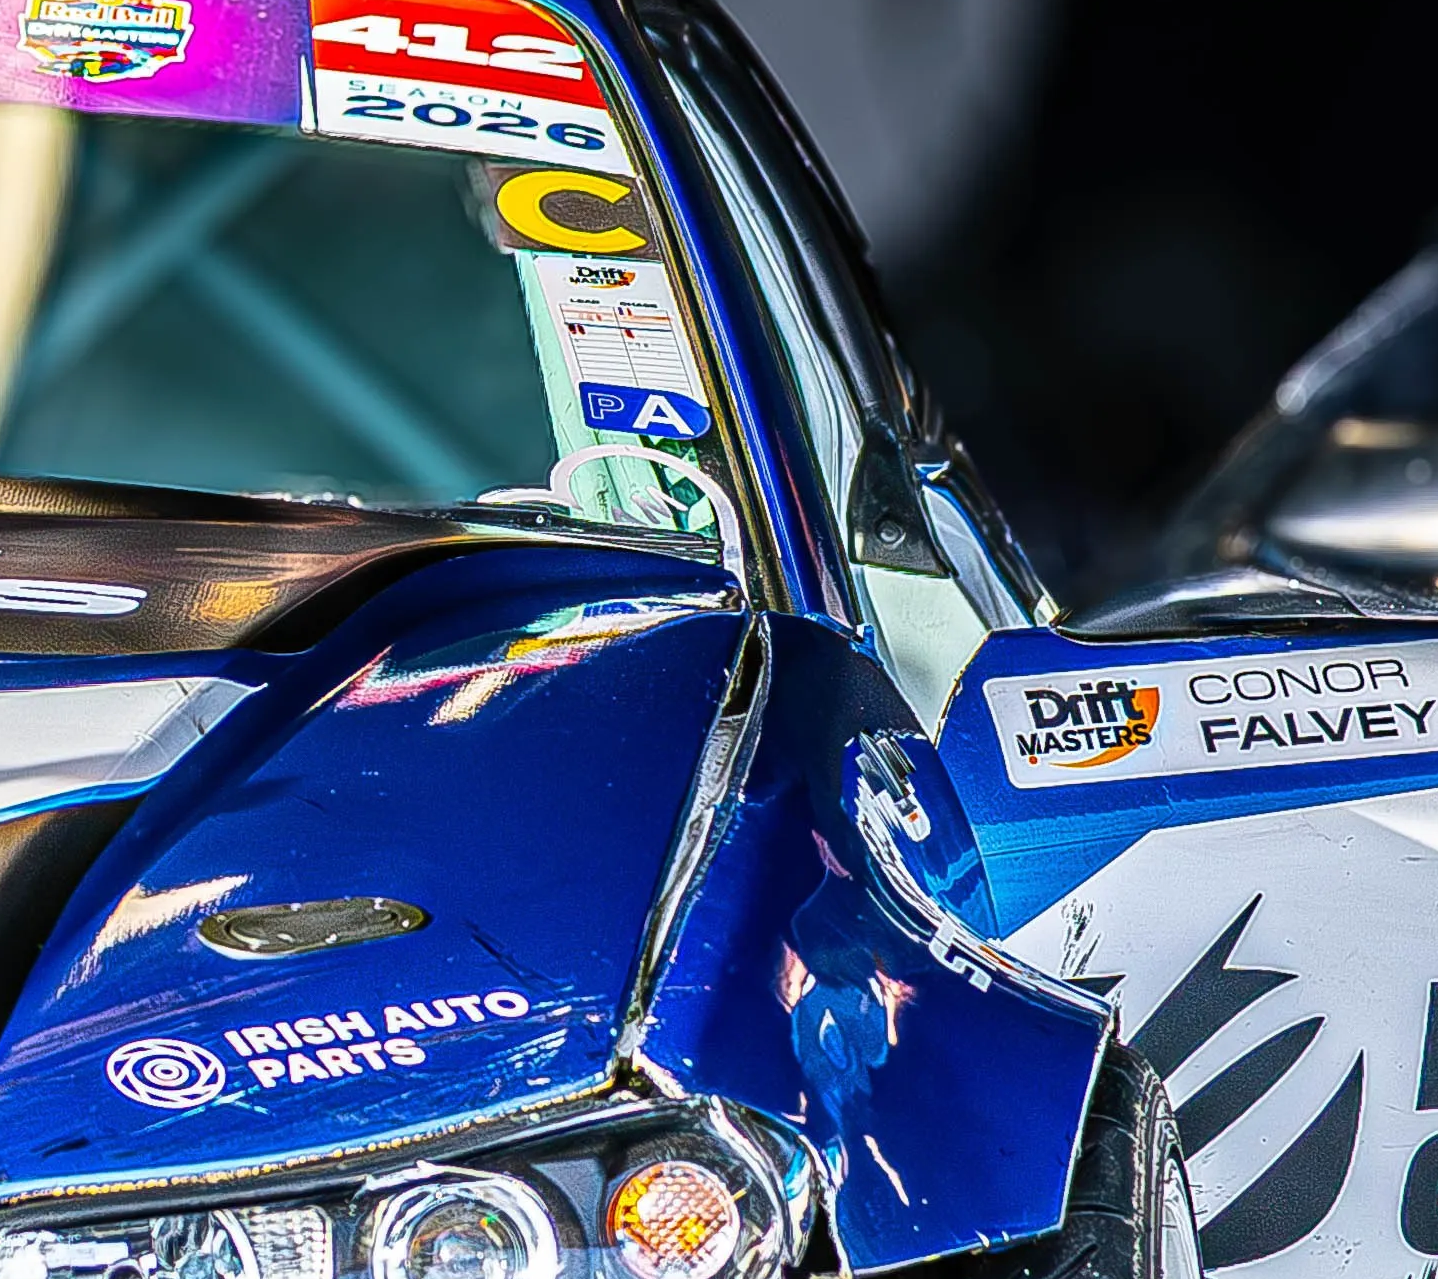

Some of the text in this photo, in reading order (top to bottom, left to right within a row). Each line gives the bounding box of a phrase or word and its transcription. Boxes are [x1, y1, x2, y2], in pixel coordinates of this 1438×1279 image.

[41, 1, 174, 26] Red Bull
[312, 15, 584, 81] 412
[348, 79, 523, 110] SEASON
[342, 95, 606, 150] 2026
[496, 170, 647, 253] C
[575, 266, 629, 280] Drift
[1023, 679, 1145, 730] Drift
[1188, 658, 1410, 705] CONOR
[1017, 722, 1151, 756] MASTERS
[1199, 699, 1437, 753] FALVEY
[224, 990, 530, 1057] IRISH AUTO
[247, 1037, 426, 1088] PARTS
